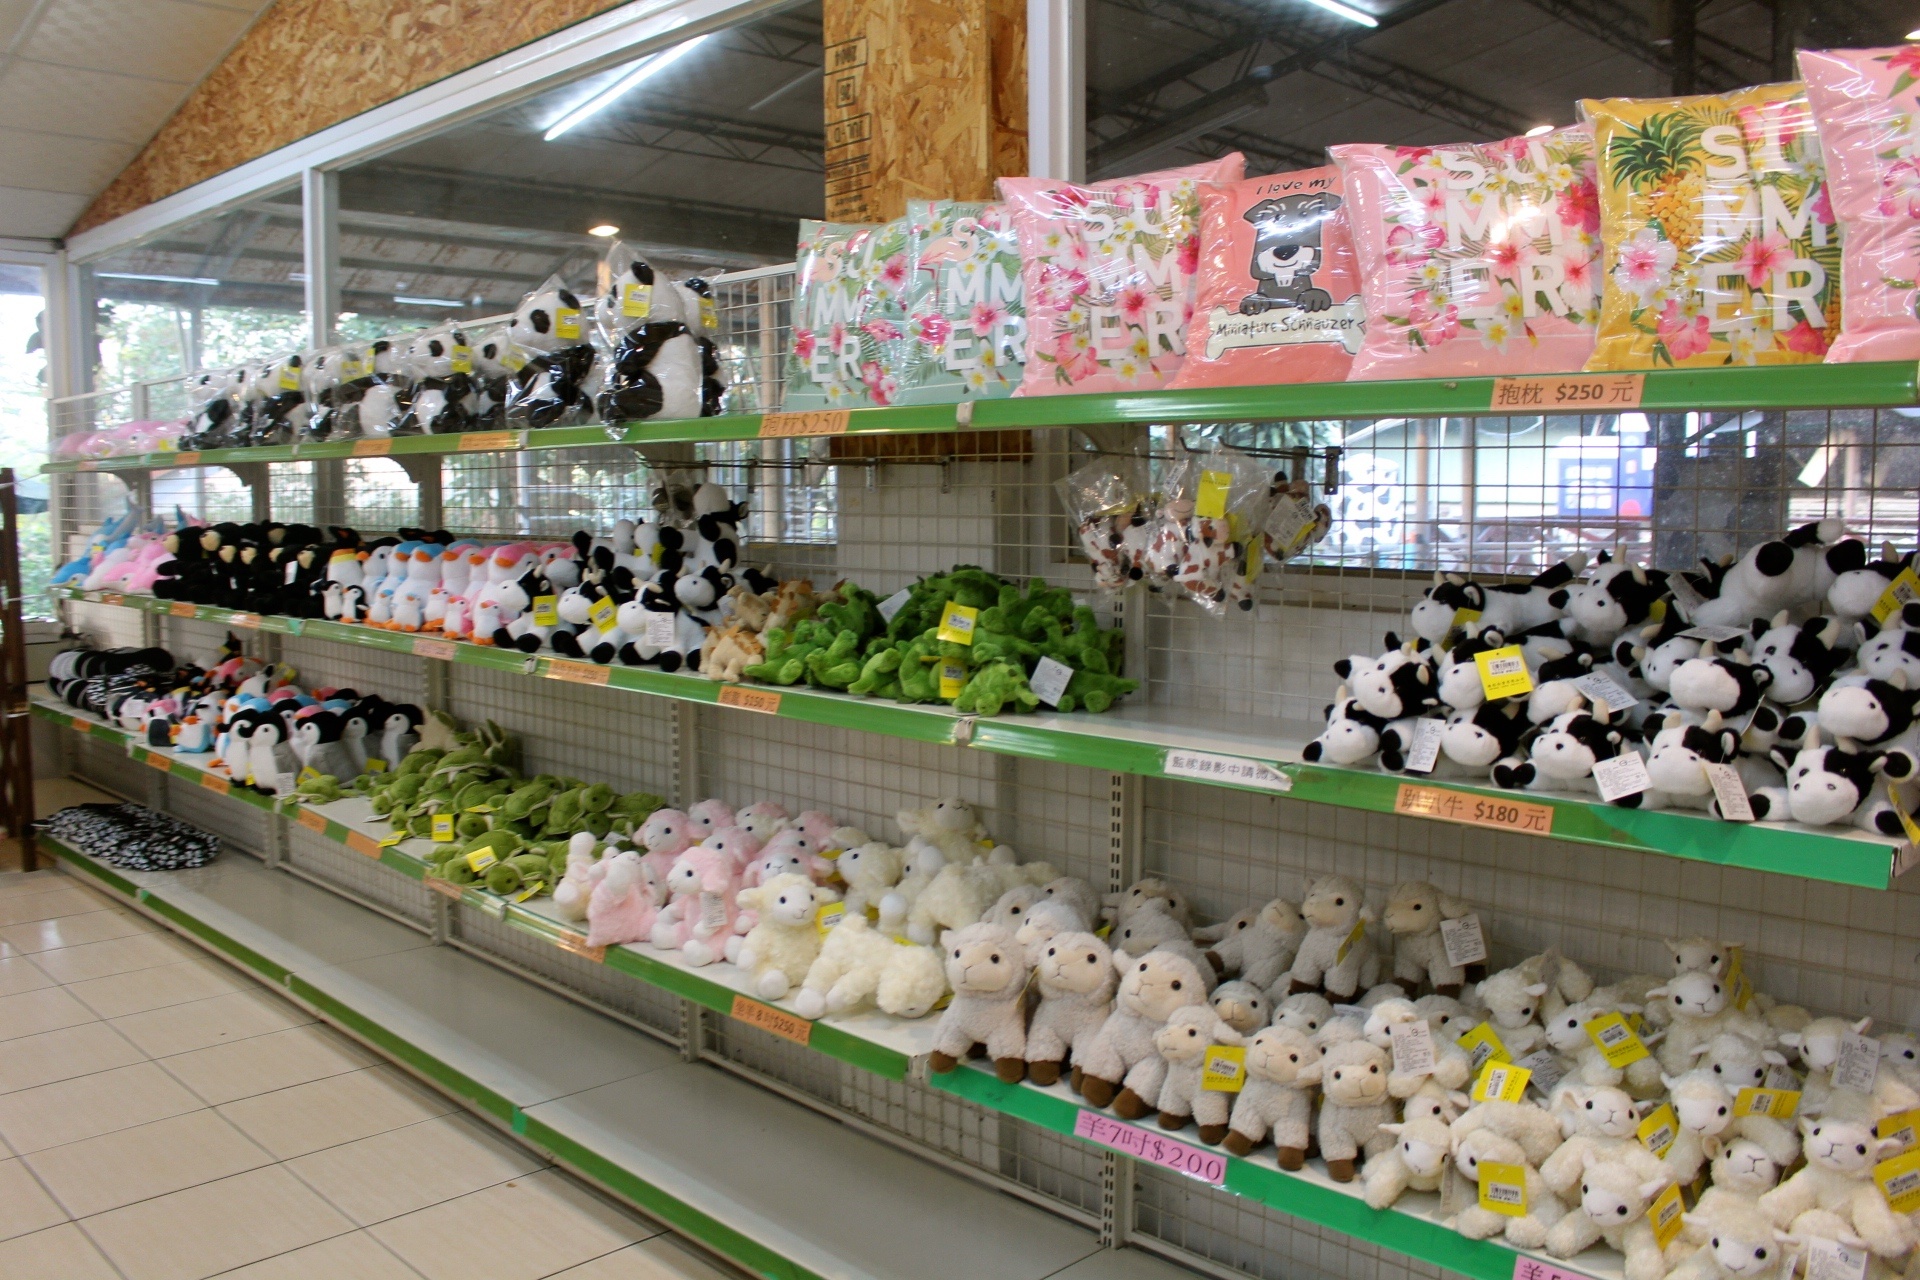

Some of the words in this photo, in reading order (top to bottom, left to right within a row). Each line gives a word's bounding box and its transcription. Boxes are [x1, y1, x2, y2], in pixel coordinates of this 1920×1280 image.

[1267, 180, 1303, 194] love
[1309, 176, 1337, 189] my
[1441, 141, 1547, 190] SU
[1079, 190, 1172, 242] SU
[1446, 190, 1563, 250] MM
[1703, 176, 1827, 248] MM
[813, 285, 866, 331] MM
[946, 262, 1025, 315] MM
[1451, 255, 1570, 319] ER
[1703, 258, 1827, 332] ER
[946, 316, 1027, 371] ER
[1091, 301, 1187, 360] ER
[1216, 321, 1277, 338] Miniature
[1280, 316, 1355, 333] Schnauzer
[811, 336, 864, 383] ER
[1498, 383, 1543, 405] 抱枕
[1555, 382, 1604, 403] $250
[1609, 380, 1634, 402] 元
[1474, 800, 1519, 824] $180
[1523, 808, 1546, 831] 元
